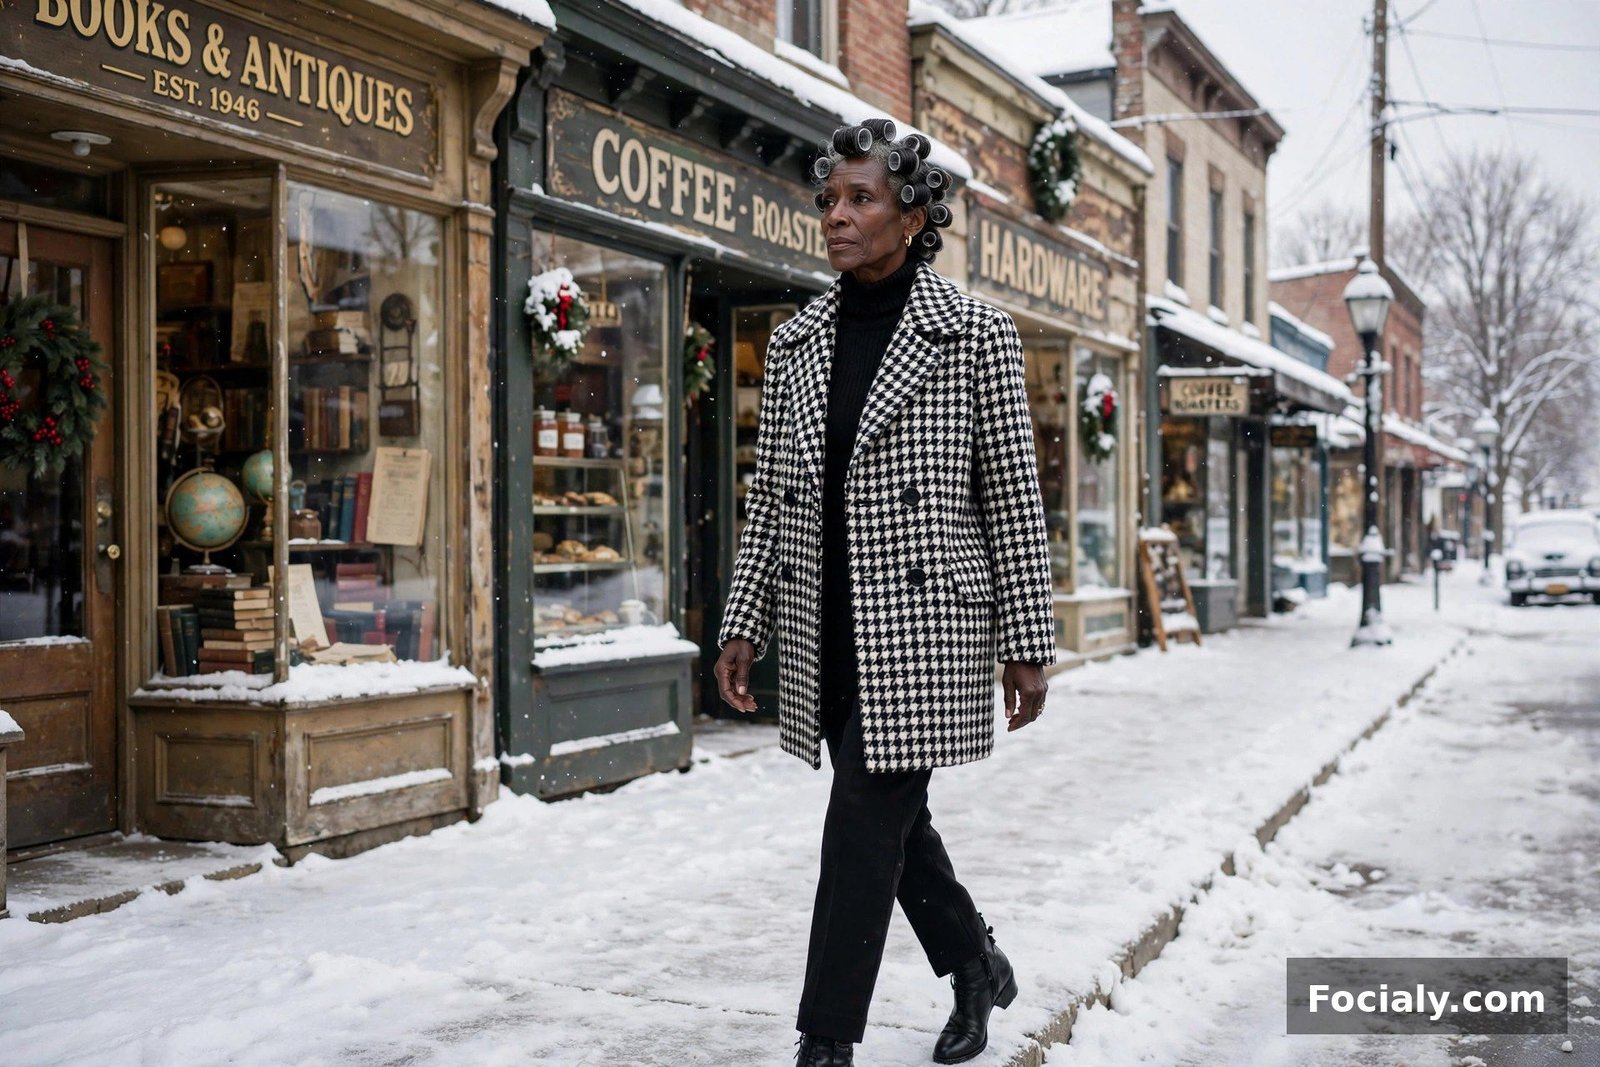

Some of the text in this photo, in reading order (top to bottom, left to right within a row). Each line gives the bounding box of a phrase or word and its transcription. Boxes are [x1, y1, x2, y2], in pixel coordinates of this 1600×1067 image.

[152, 69, 260, 121] EST. 1946
[202, 23, 232, 77] &
[240, 36, 414, 136] ANTIQUES
[592, 128, 736, 232] COFFEE
[980, 219, 1104, 314] HARDWARE
